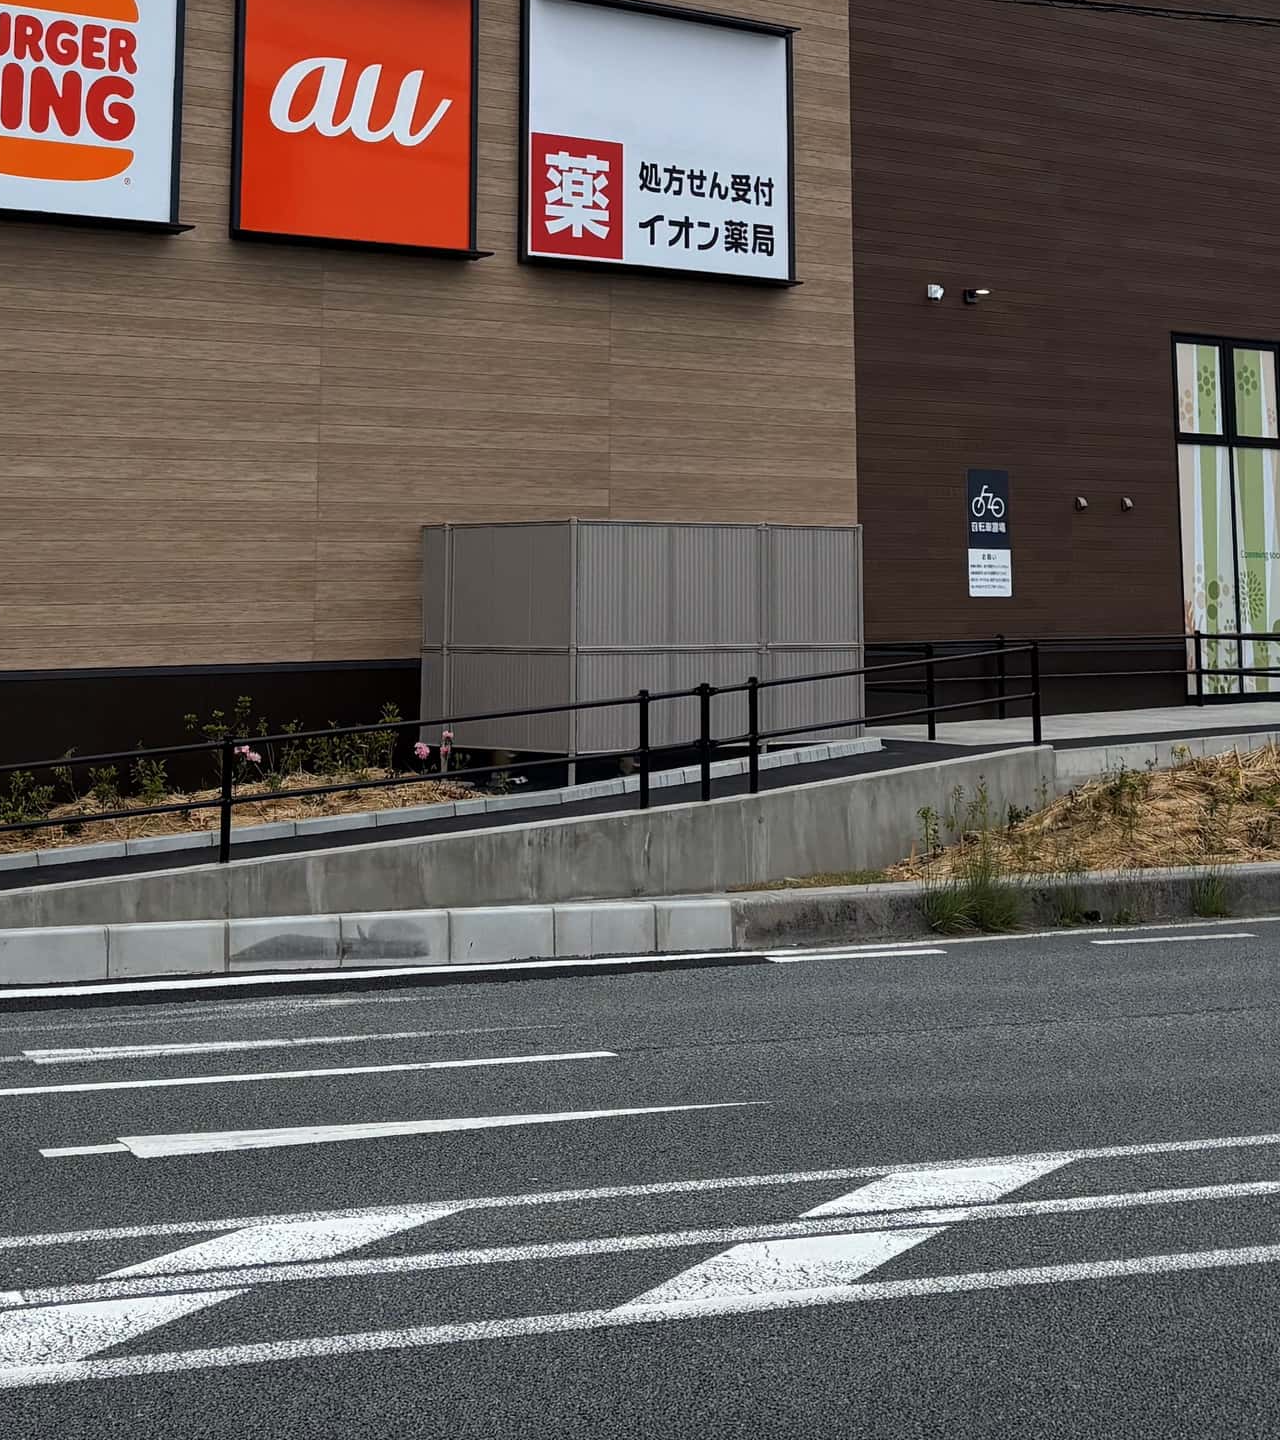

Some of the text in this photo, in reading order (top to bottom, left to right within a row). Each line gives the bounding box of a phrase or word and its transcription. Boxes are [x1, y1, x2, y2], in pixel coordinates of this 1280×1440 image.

[269, 56, 453, 147] au
[544, 151, 610, 240] 薬
[638, 161, 774, 208] 処方せん受付
[638, 214, 775, 258] イオン薬局
